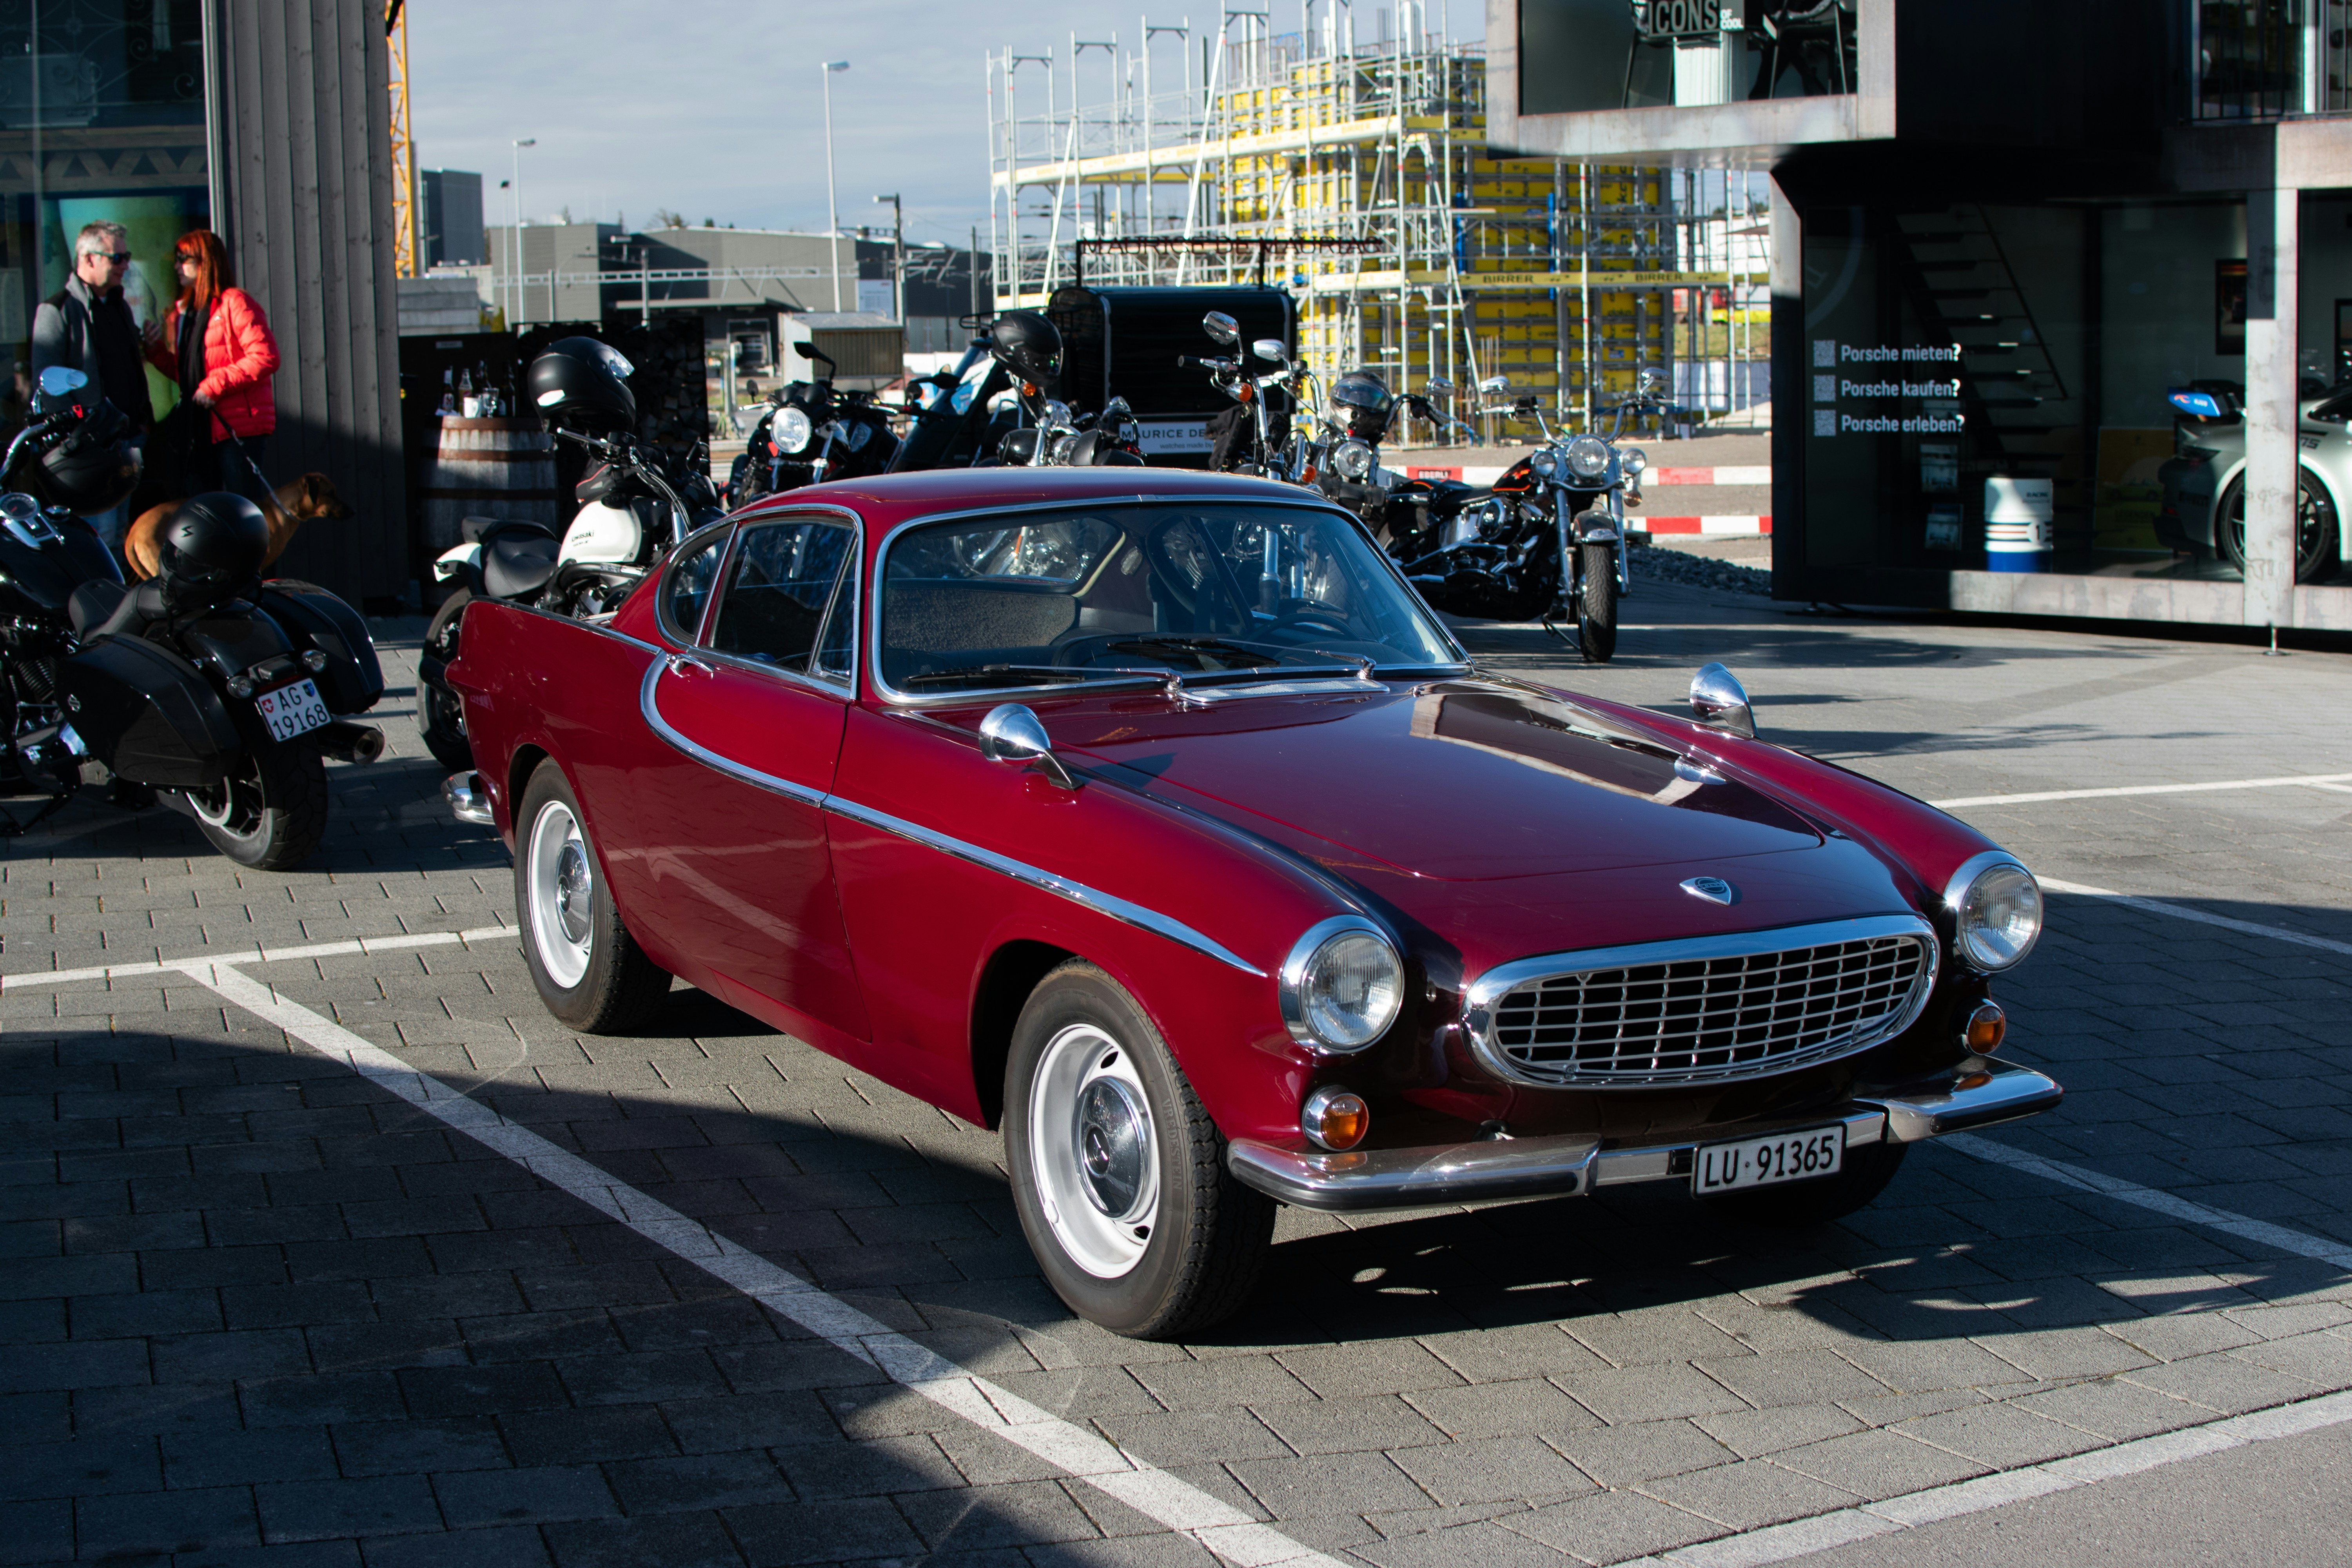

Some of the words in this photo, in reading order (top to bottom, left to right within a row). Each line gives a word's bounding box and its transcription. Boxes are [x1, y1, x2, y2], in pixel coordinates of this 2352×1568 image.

[1648, 0, 1718, 34] ICONS
[1720, 9, 1733, 19] OF
[1720, 18, 1744, 30] COOL
[1082, 236, 1205, 254] MAURICE
[1216, 236, 1249, 254] DE
[1483, 274, 1534, 283] BIRRER
[1635, 273, 1683, 281] BIRRER
[1841, 344, 1899, 361] Porsche
[1902, 343, 1961, 361] mieten?
[1841, 379, 1899, 397] Porsche
[1902, 378, 1960, 397] kaufen?
[1841, 414, 1899, 432] Porsche
[1902, 414, 1965, 432] erleben?
[277, 686, 302, 711] AG
[272, 703, 328, 739] 19168
[1161, 1098, 1183, 1190] VREDESTEIN
